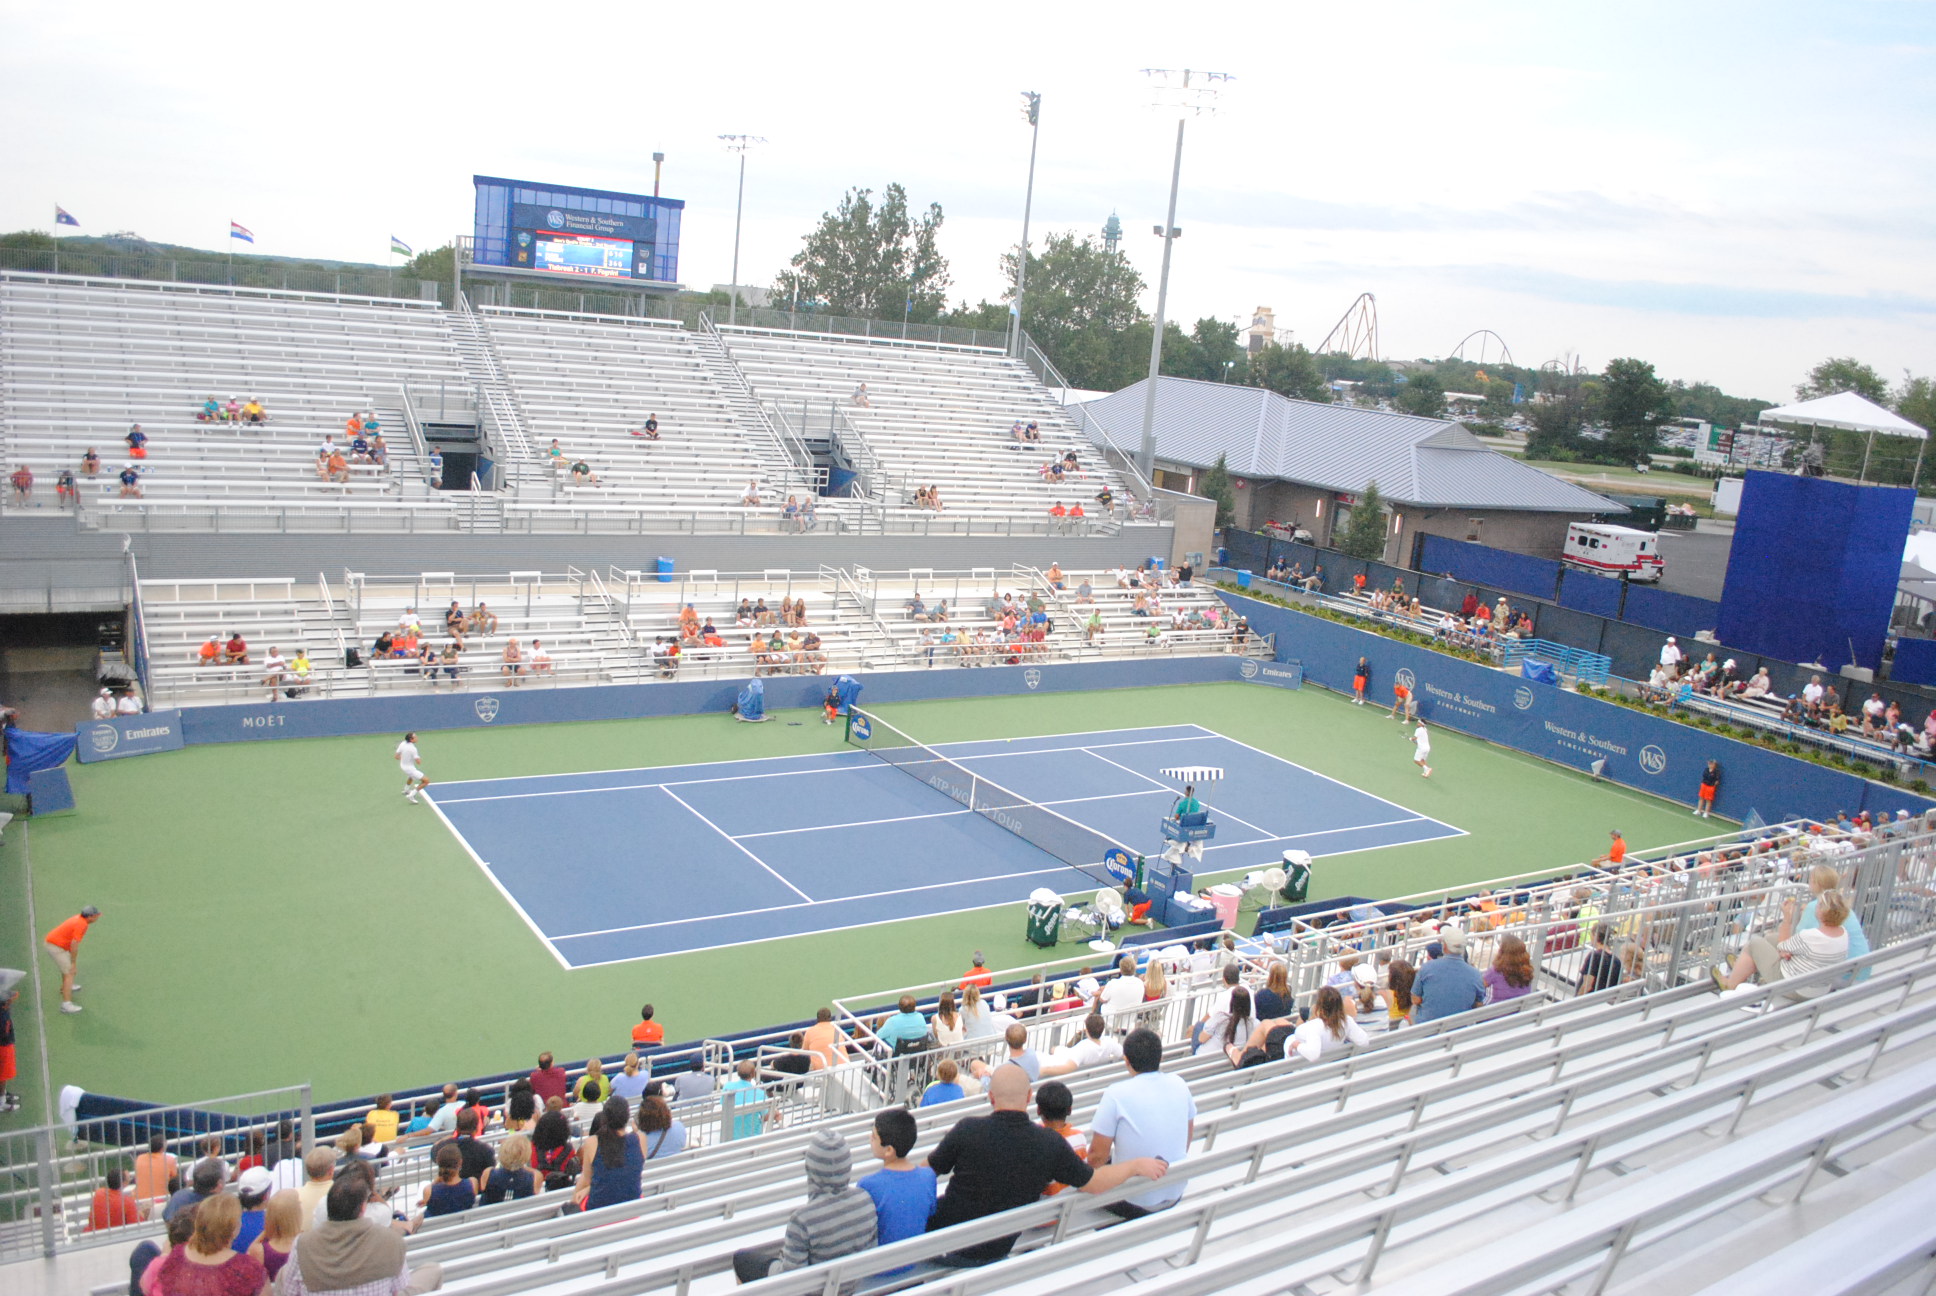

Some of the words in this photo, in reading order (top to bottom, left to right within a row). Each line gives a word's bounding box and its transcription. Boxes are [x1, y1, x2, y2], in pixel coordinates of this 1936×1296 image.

[565, 213, 590, 224] Western
[590, 216, 596, 224] &
[597, 217, 624, 227] Southern
[566, 221, 594, 230] Financial
[594, 225, 615, 234] Group
[1262, 667, 1292, 679] Emirates
[1425, 682, 1453, 700] Western
[1453, 692, 1462, 703] &
[1462, 695, 1496, 714] Southern
[126, 726, 170, 740] Emirates
[1544, 720, 1577, 740] Western
[1577, 731, 1586, 743] &
[1587, 735, 1628, 756] Southern
[929, 775, 949, 791] ATP
[989, 807, 1023, 834] TOUR
[1105, 857, 1134, 879] Corona
